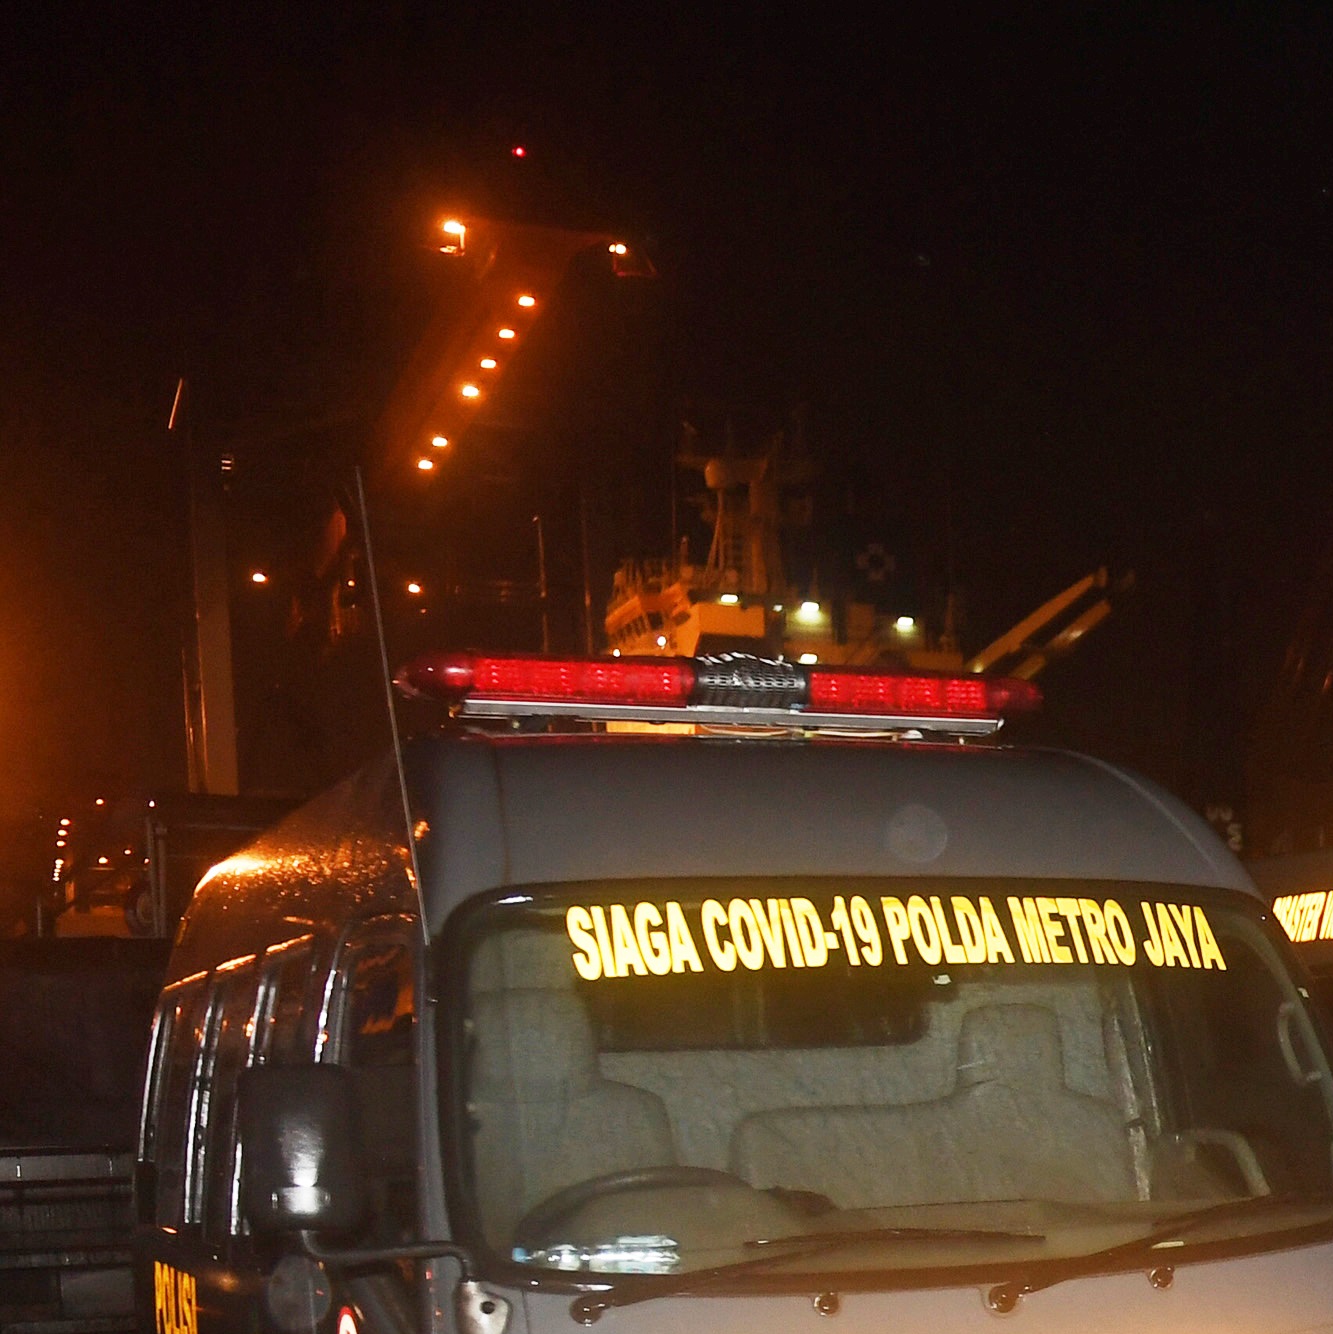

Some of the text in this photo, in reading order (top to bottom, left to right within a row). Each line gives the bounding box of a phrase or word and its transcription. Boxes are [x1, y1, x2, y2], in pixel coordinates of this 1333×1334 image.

[566, 895, 1228, 981] SIAGA COVID-19 POLDA METRO JAYA
